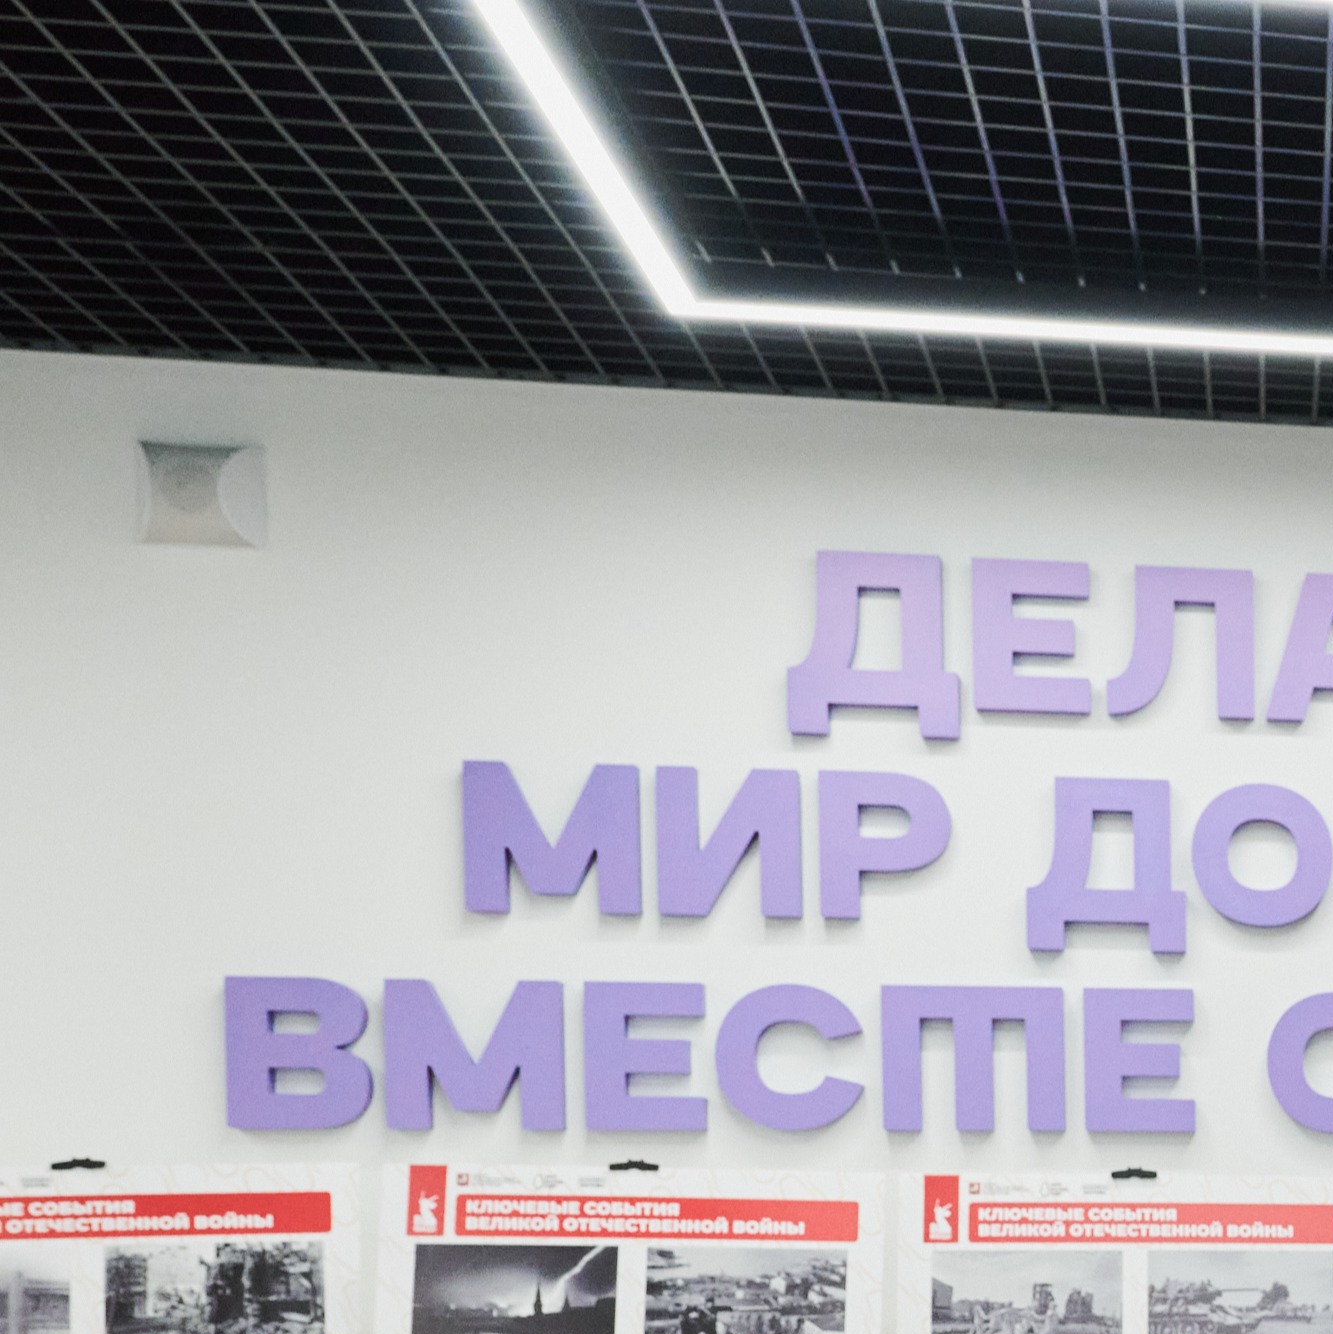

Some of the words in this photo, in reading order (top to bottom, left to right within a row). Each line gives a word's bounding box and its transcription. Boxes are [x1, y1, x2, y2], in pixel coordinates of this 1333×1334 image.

[462, 760, 951, 921] МИР
[224, 975, 1197, 1134] ВМЕСТЕ
[27, 1199, 136, 1216] СОБЫТИЯ
[465, 1199, 581, 1216] КЛЮЧЕВЫЕ
[583, 1200, 681, 1218] СОБЫТИЯ
[977, 1207, 1085, 1222] КЛЮЧЕВЫЕ
[1088, 1207, 1177, 1223] СОБЫТИЯ
[5, 1212, 190, 1234] ОТЕЧЕСТВЕННОЙ
[193, 1210, 275, 1230] ВОЙНЫ
[465, 1214, 559, 1231] ВЕЛИКОЙ
[562, 1215, 729, 1235] ОТЕЧЕСТВЕННОЙ
[732, 1216, 806, 1236] ВОЙНЫ
[977, 1220, 1067, 1238] ВЕЛИКОЙ
[1069, 1220, 1224, 1239] ОТЕЧЕСТВЕННОЙ
[1226, 1220, 1294, 1239] ВОЙНЫ
